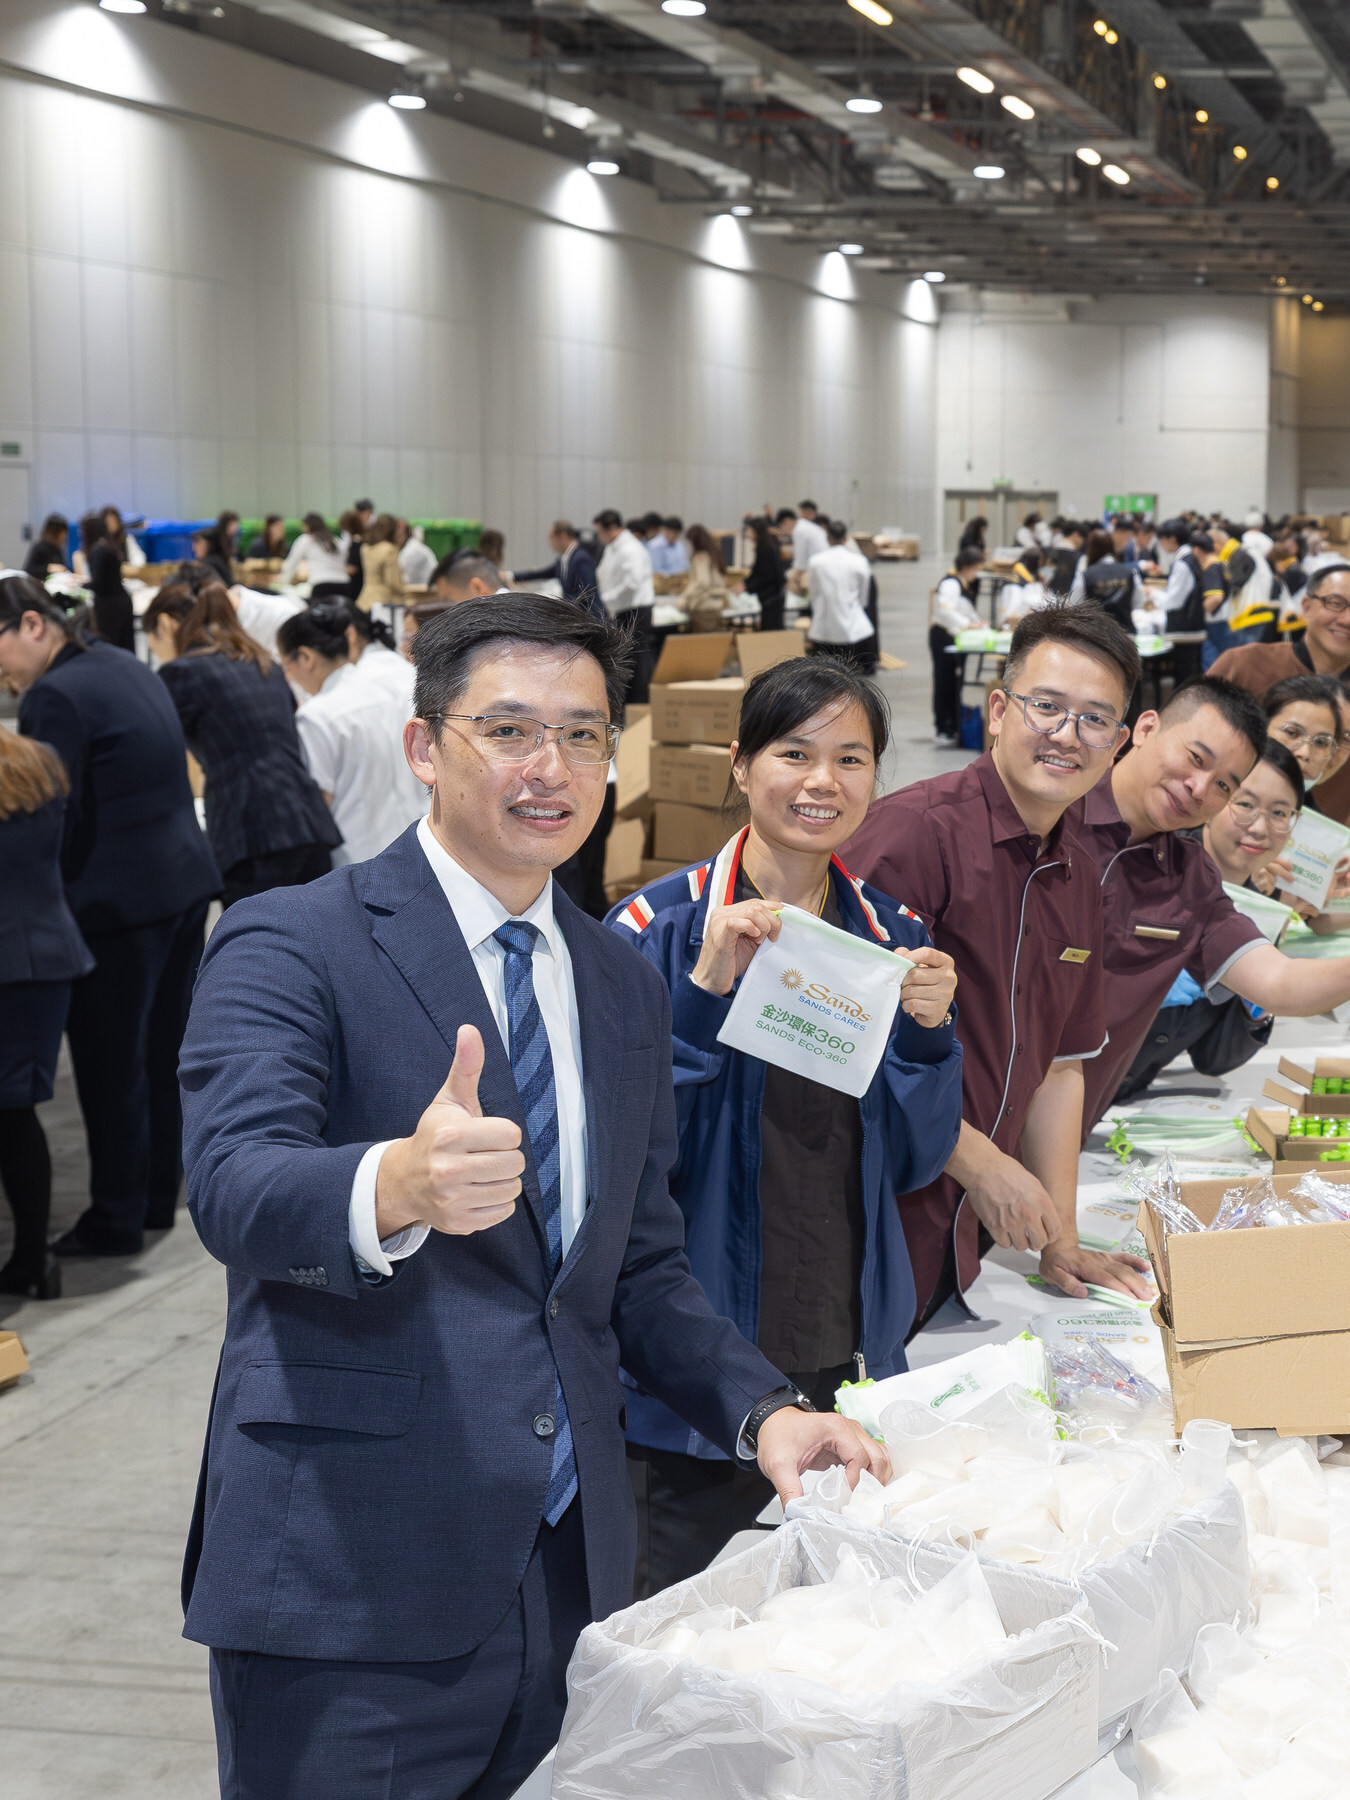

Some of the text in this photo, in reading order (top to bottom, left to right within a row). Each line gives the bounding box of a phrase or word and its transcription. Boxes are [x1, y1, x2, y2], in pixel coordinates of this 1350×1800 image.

[798, 995, 867, 1032] SANDS CARES
[803, 983, 873, 1023] Sands
[755, 1020, 795, 1042] SANDS
[760, 1004, 856, 1054] 金沙環保360
